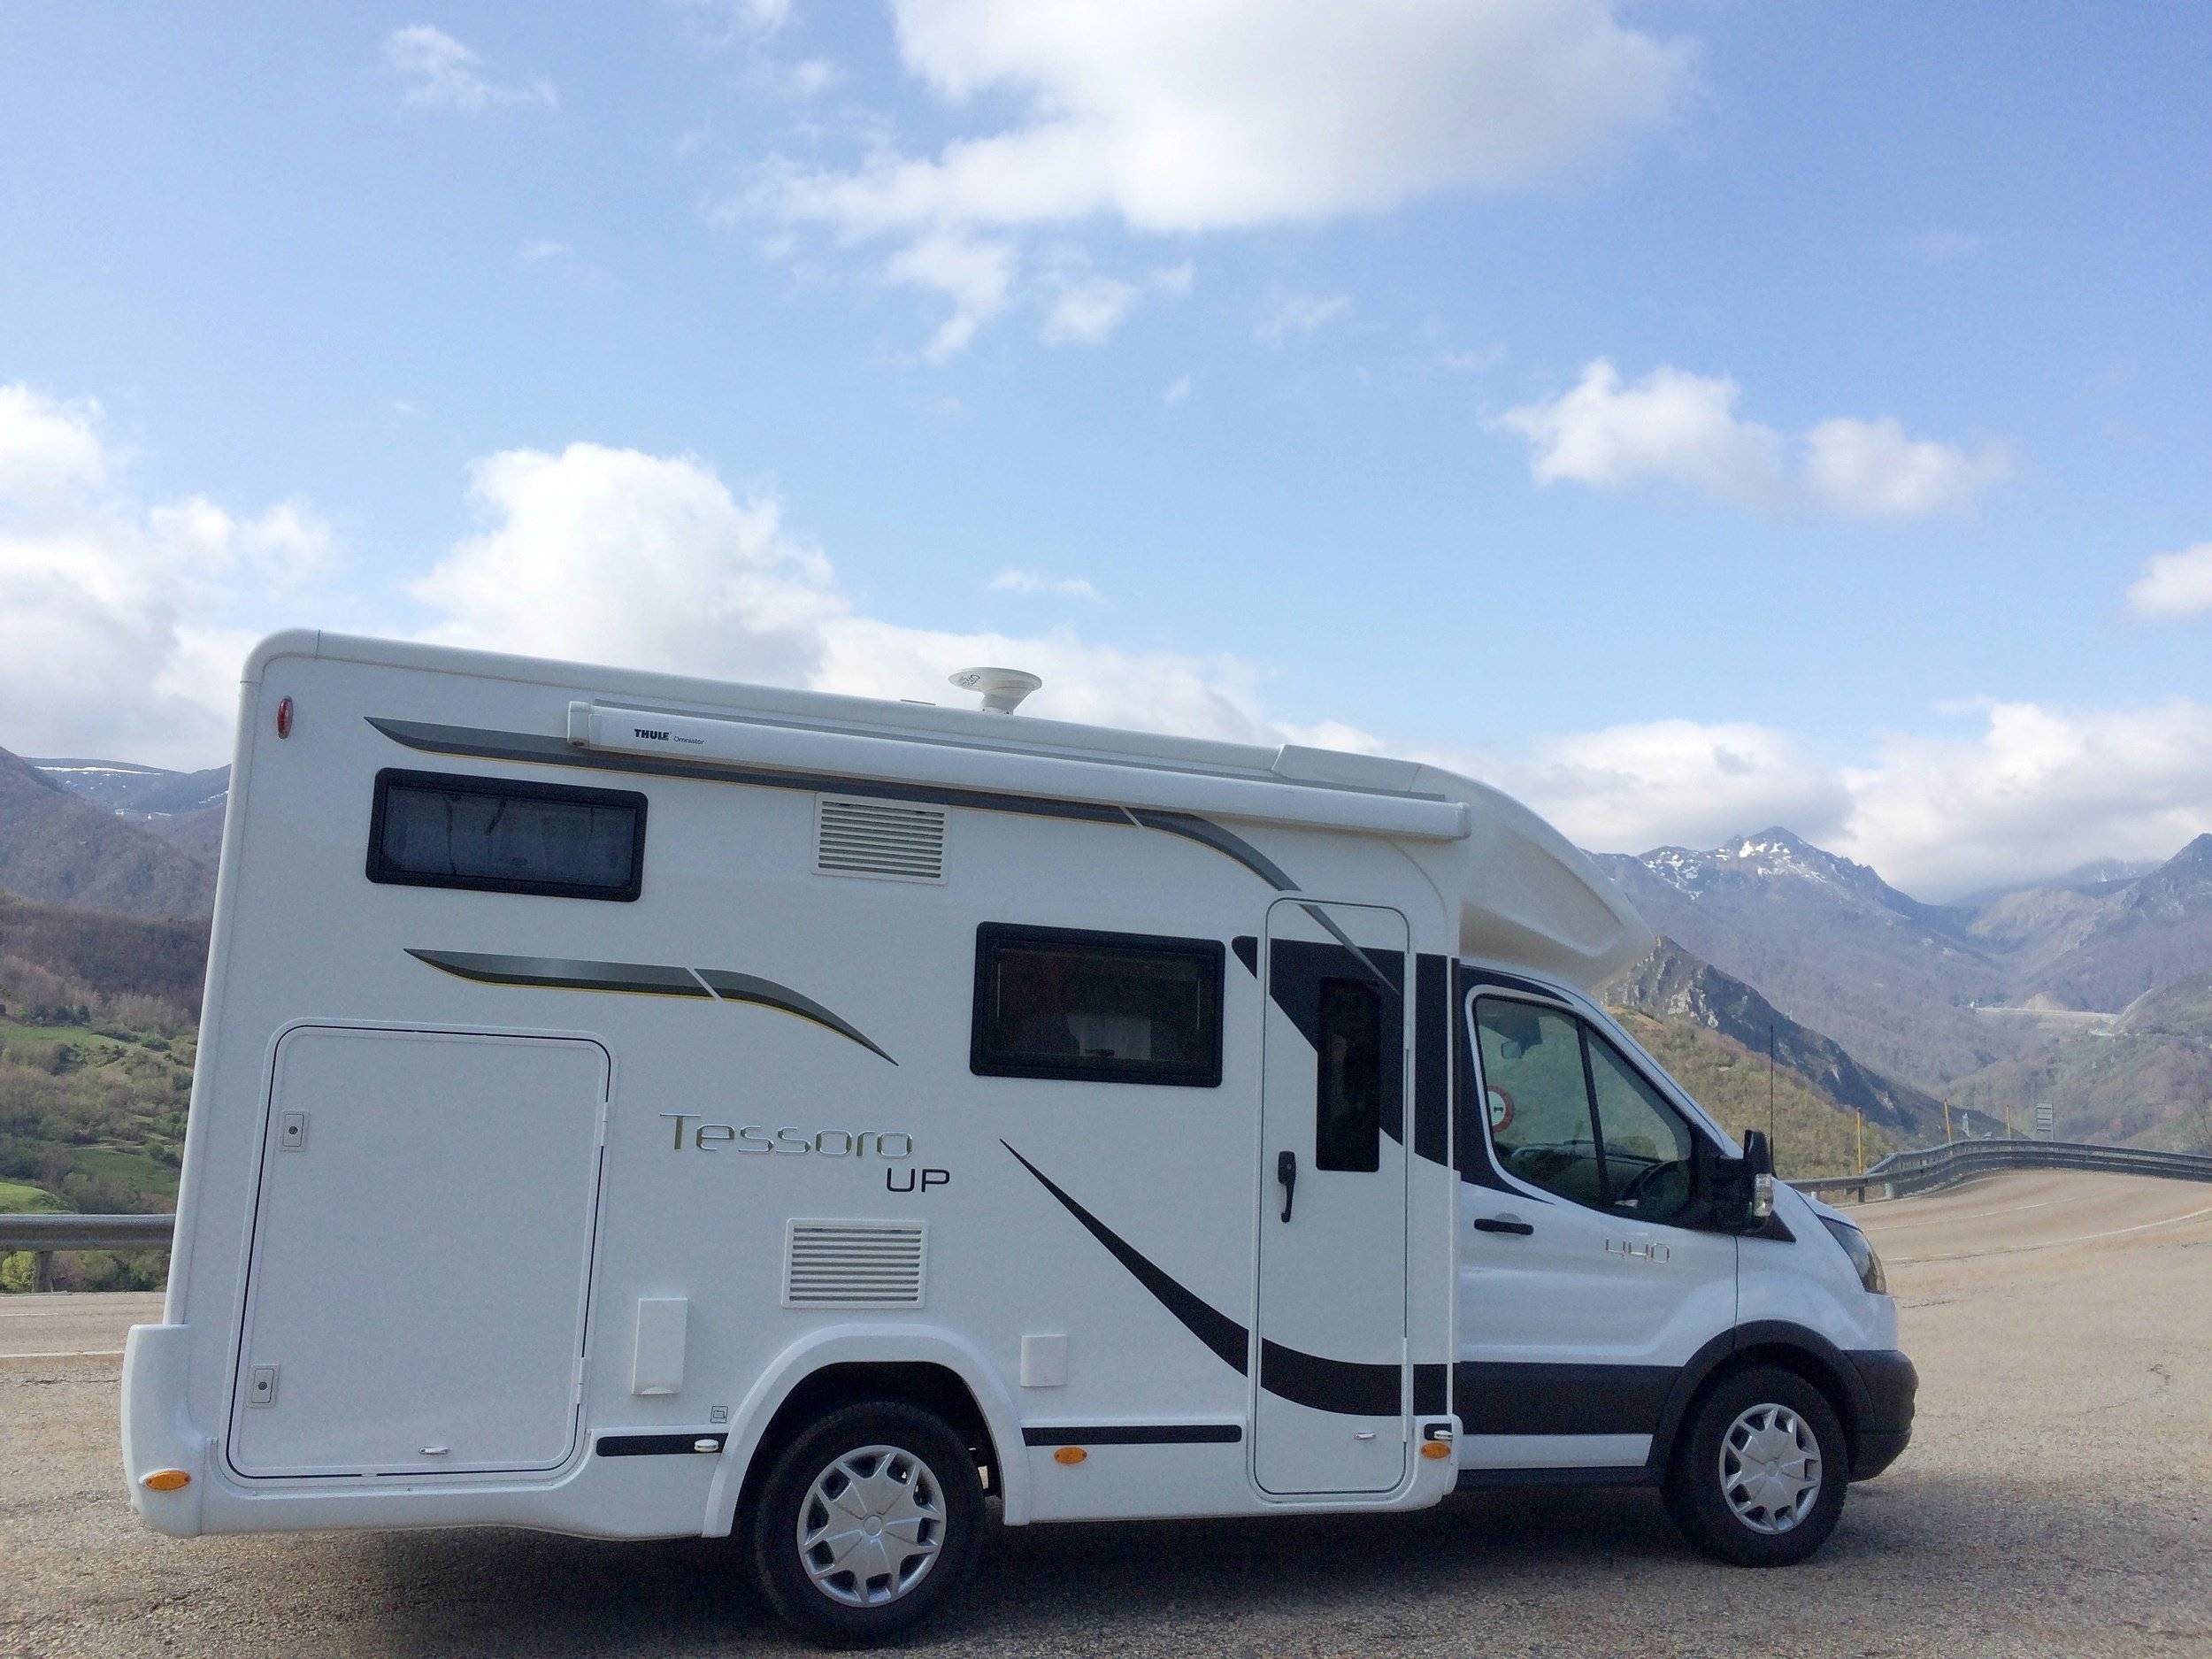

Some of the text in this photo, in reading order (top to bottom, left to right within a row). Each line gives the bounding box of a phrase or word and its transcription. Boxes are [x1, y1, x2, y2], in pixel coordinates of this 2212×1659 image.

[634, 729, 705, 745] THULE Omnistor
[659, 1112, 912, 1159] Tessoro
[887, 1168, 950, 1193] UP
[1605, 1239, 1670, 1263] 440
